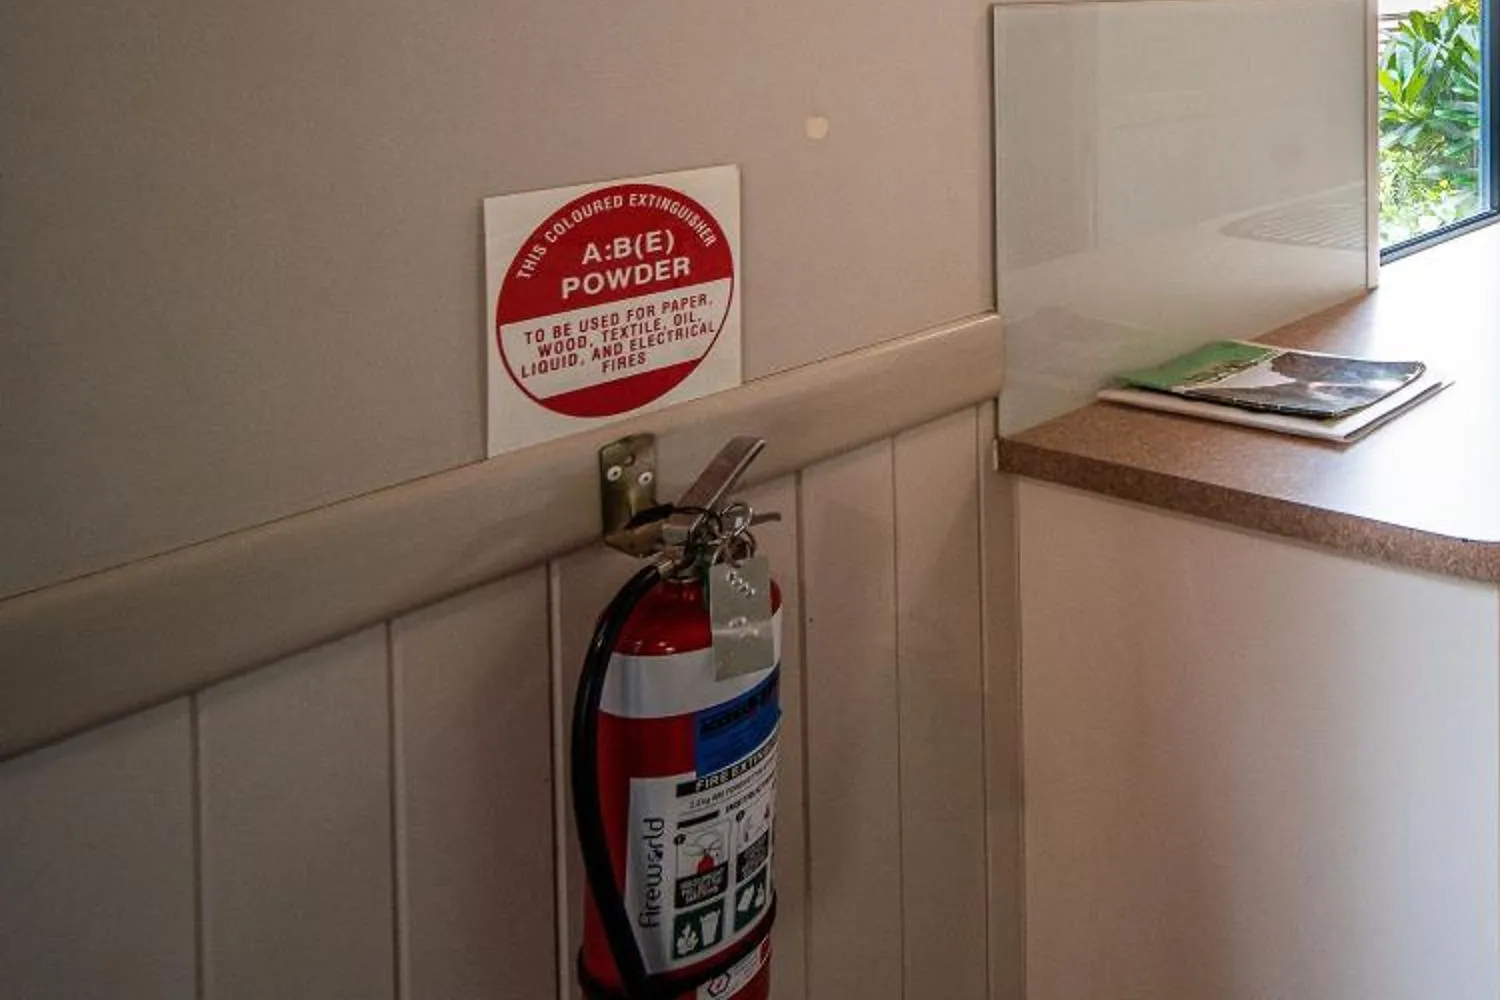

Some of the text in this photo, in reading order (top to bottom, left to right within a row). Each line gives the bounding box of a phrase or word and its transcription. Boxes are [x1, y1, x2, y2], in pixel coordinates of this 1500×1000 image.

[516, 193, 718, 280] THIS COLOURED EXTINGUISHER
[562, 256, 691, 299] POWDER
[524, 329, 545, 345] TO
[553, 324, 571, 339] BE
[580, 315, 620, 334] USED
[627, 305, 655, 322] FOR
[592, 343, 623, 360] AND
[630, 322, 715, 352] ELECTRICAL
[602, 352, 647, 373] FIRES
[639, 817, 665, 928] fireworld
